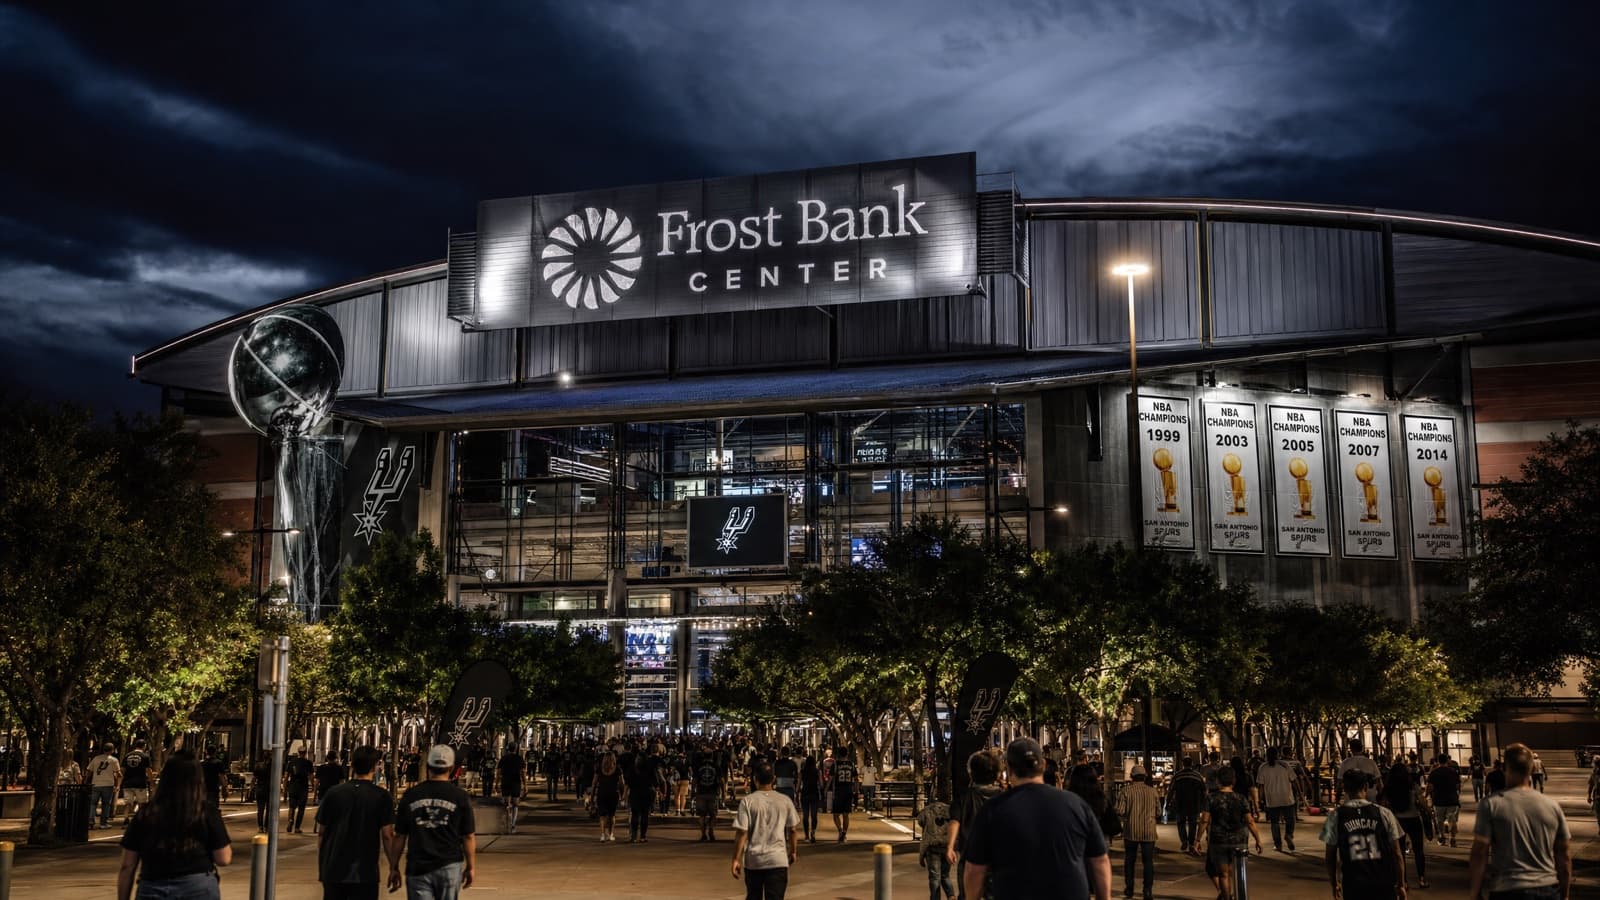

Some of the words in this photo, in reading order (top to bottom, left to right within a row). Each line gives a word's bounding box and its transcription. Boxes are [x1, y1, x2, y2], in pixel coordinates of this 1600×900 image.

[657, 207, 782, 256] Frost
[797, 184, 928, 245] Bank
[689, 258, 887, 292] CENTER
[1153, 402, 1172, 412] NBA
[1221, 408, 1239, 417] NBA
[1139, 413, 1187, 424] CHAMPIONS
[1207, 418, 1254, 429] CHAMPIONS
[1287, 413, 1305, 423] NBA
[1353, 417, 1371, 427] NBA
[1273, 423, 1320, 434] CHAMPIONS
[1421, 422, 1438, 431] NBA
[1147, 429, 1180, 442] 1999
[1340, 427, 1386, 438] CHAMPIONS
[1408, 433, 1453, 443] CHAMPIONS
[1216, 434, 1248, 447] 2003
[1282, 439, 1315, 452] 2005
[1348, 444, 1380, 456] 2007
[1417, 449, 1448, 461] 2014
[1160, 520, 1189, 528] ANTONIO
[1154, 528, 1181, 537] SPURS
[1224, 531, 1250, 540] SPURS
[1291, 534, 1317, 543] SPURS
[1357, 537, 1383, 546] SPURS
[1426, 540, 1451, 549] SPURS
[1344, 818, 1378, 832] DUNCAN
[1349, 834, 1381, 860] 21
